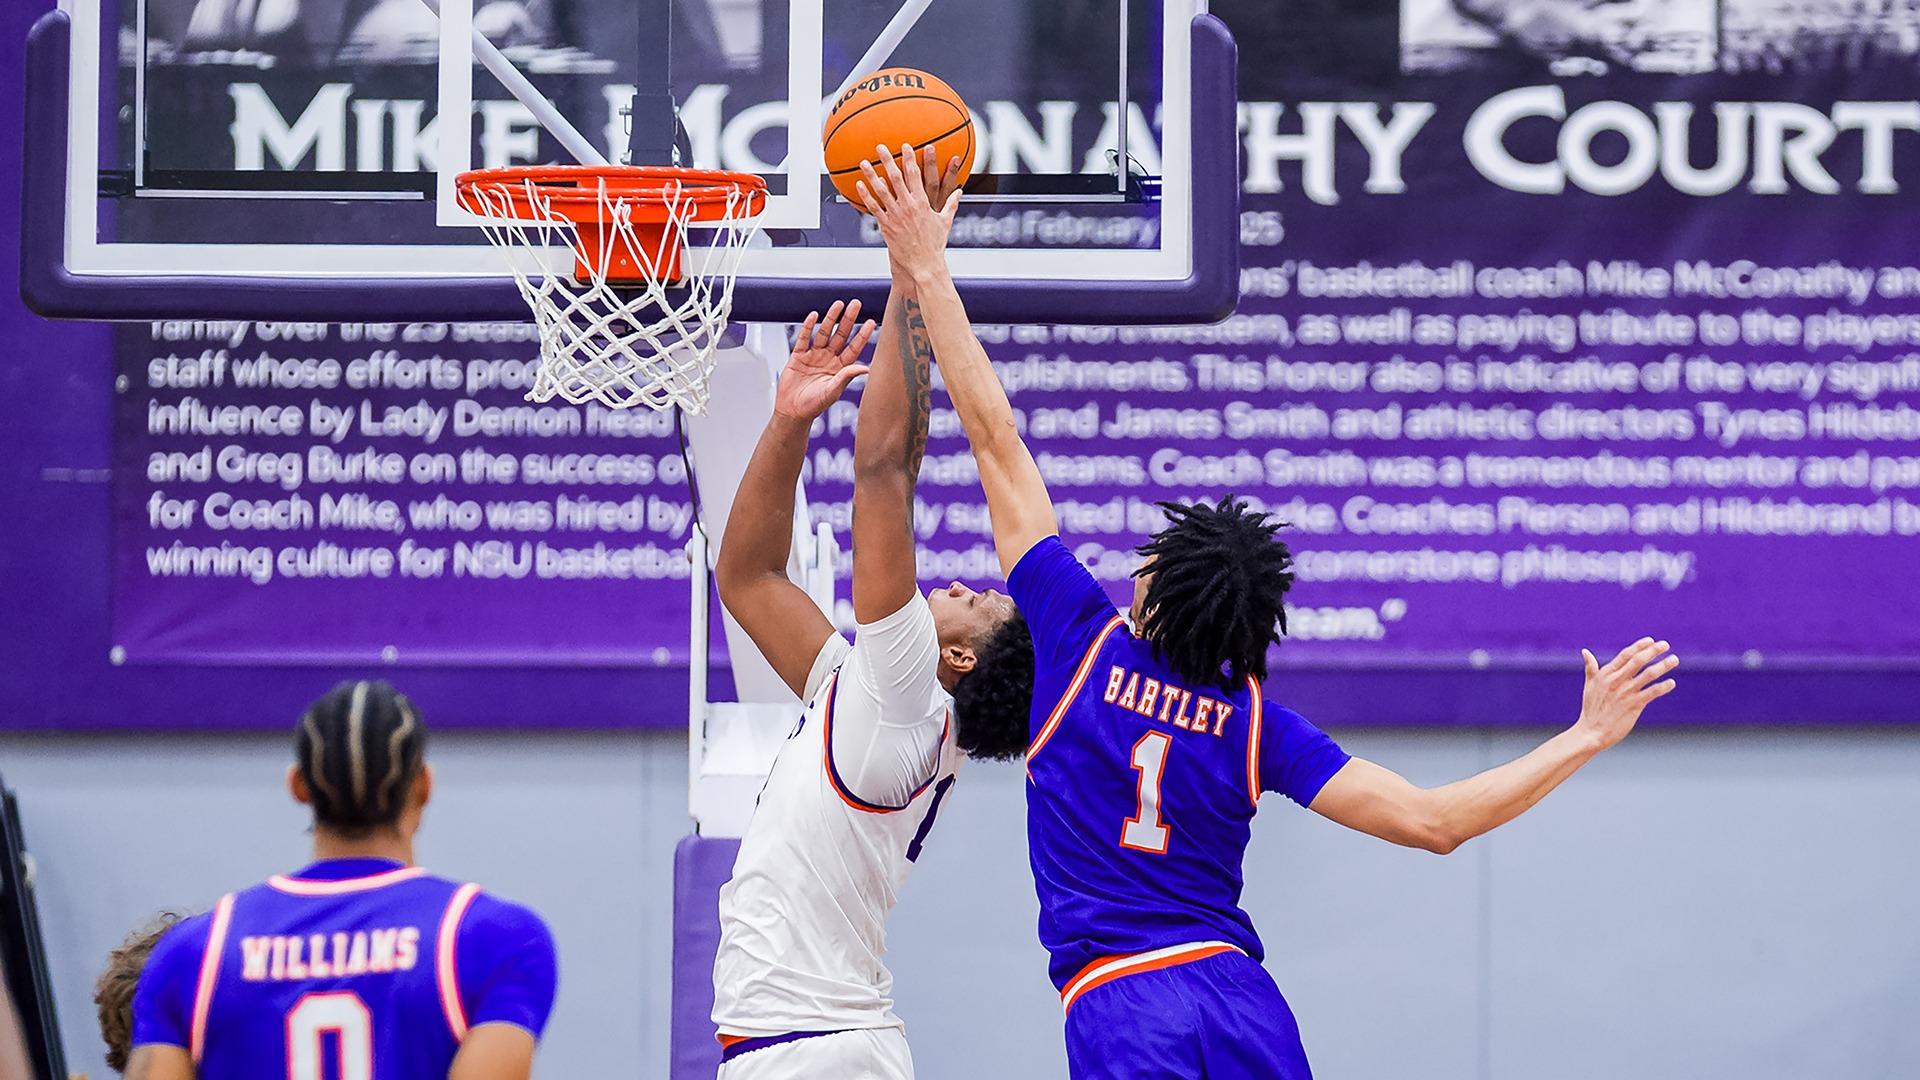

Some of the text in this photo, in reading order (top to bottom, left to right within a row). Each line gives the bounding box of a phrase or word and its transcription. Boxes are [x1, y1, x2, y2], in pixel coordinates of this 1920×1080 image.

[832, 73, 926, 115] Wilson
[1463, 85, 1920, 196] COURT
[1297, 259, 1474, 299] basketball
[1475, 260, 1584, 299] coach
[1586, 260, 1672, 299] Mike
[1673, 259, 1875, 306] McConathy
[1875, 266, 1920, 299] an
[1297, 314, 1341, 345] as
[1341, 308, 1411, 344] well
[1413, 314, 1457, 345] as
[1457, 308, 1577, 352] paying
[1578, 307, 1697, 345] tribute
[1699, 312, 1741, 345] to
[1741, 307, 1801, 345] the
[148, 349, 229, 388] staff
[231, 351, 343, 389] whose
[345, 350, 464, 390] efforts
[1190, 354, 1265, 392] This
[1265, 354, 1368, 392] honor
[1370, 354, 1445, 393] also
[1444, 355, 1476, 393] is
[1639, 353, 1683, 393] of
[1684, 354, 1746, 393] the
[1747, 362, 1826, 401] very
[148, 396, 303, 436] influence
[310, 398, 354, 442] by
[360, 399, 448, 443] Lady
[453, 401, 581, 437] Demon
[586, 401, 675, 437] head
[1029, 401, 1099, 440] and
[1101, 401, 1222, 440] James
[1223, 401, 1330, 440] Smith
[1331, 402, 1402, 440] and
[1404, 402, 1536, 440] athletic
[1537, 402, 1695, 440] directors
[147, 445, 211, 483] and
[216, 444, 302, 490] Greg
[308, 445, 405, 483] Burke
[409, 452, 455, 484] on
[460, 448, 518, 484] the
[521, 452, 656, 485] success
[1149, 448, 1264, 487] Coach
[1264, 450, 1366, 487] Smith
[1367, 457, 1438, 488] was
[1437, 457, 1464, 488] a
[1464, 450, 1672, 488] tremendous
[1673, 451, 1797, 488] mentor
[1800, 449, 1870, 488] and
[1870, 456, 1920, 494] pa
[147, 490, 197, 530] for
[203, 492, 313, 530] Coach
[319, 493, 404, 534] Mike,
[408, 494, 482, 530] who
[485, 499, 553, 531] was
[557, 494, 644, 532] hired
[648, 494, 693, 539] by
[1342, 495, 1496, 535] Coaches
[1500, 496, 1629, 535] Pierson
[1630, 496, 1701, 535] and
[146, 540, 273, 584] winning
[277, 540, 394, 578] culture
[398, 540, 447, 577] for
[453, 540, 531, 577] NSU
[536, 541, 691, 579] basketba
[1294, 547, 1499, 582] cornerstone
[1104, 665, 1233, 737] BARTLEY
[1119, 730, 1173, 855] 1
[241, 927, 420, 982] WILLIAMS
[286, 991, 374, 1080] 0
